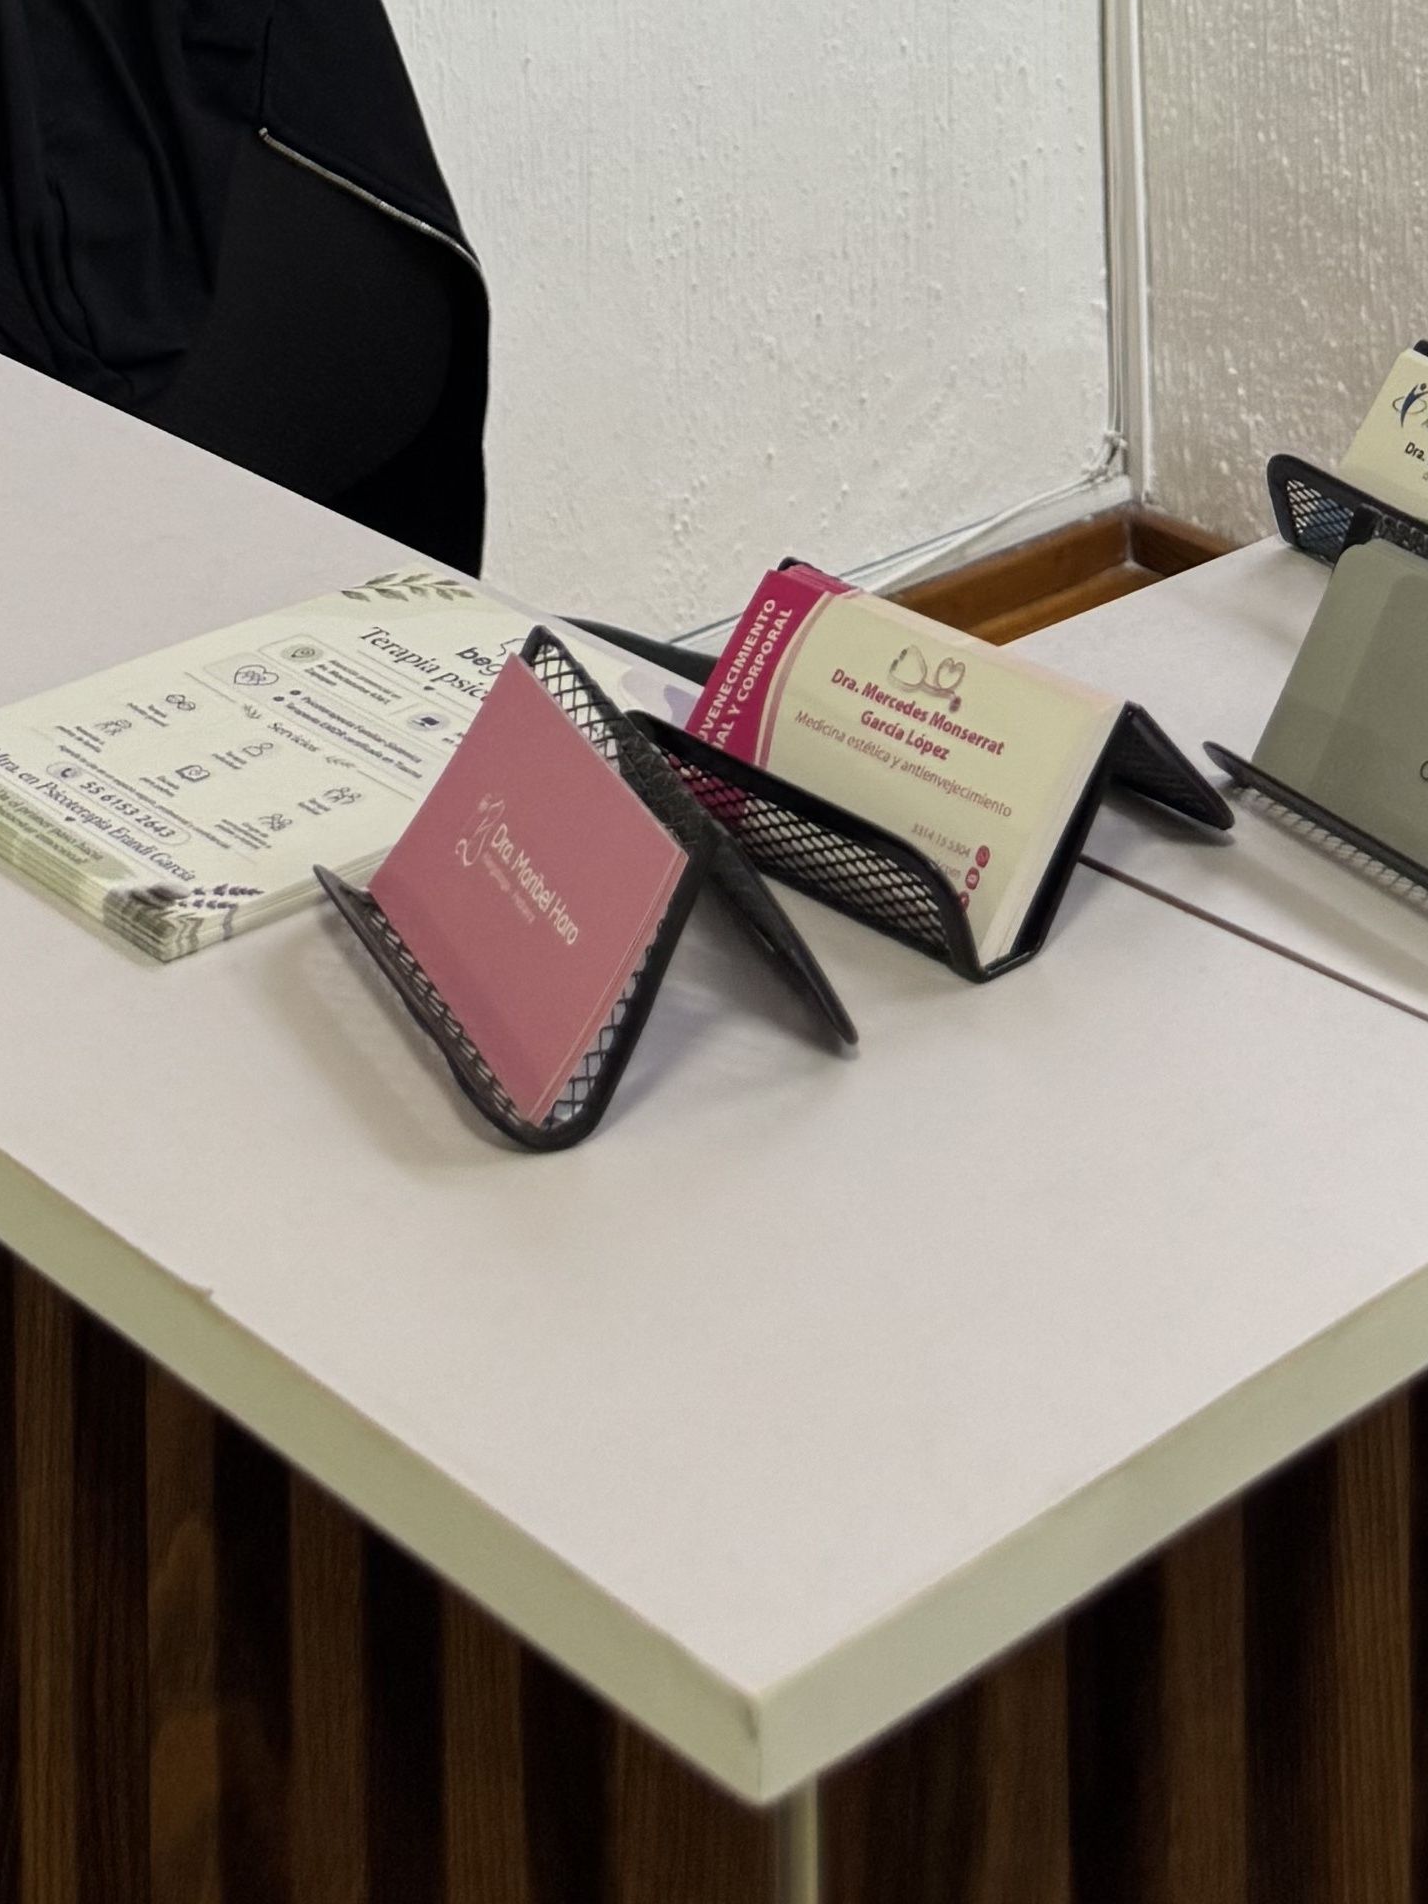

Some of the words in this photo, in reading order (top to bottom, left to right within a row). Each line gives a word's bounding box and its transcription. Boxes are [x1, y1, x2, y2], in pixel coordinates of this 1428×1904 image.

[1404, 442, 1425, 462] Dra.
[359, 626, 440, 673] Terapia
[429, 672, 489, 702] psic
[728, 703, 740, 715] Y
[737, 608, 793, 702] CORPORAL
[266, 721, 325, 752] Servicios
[831, 668, 859, 693] Dra.
[861, 682, 929, 722] Mercedes
[928, 711, 1005, 756] Monserrat
[860, 710, 905, 742] García
[905, 728, 950, 761] López
[794, 710, 846, 742] Medicina
[847, 734, 891, 763] estética
[891, 755, 902, 769] y
[900, 758, 1013, 818] antienvejecimiento
[16, 771, 42, 784] en
[31, 781, 119, 831] Psicoterapia
[107, 826, 158, 855] Erandi
[146, 851, 200, 881] García
[79, 780, 106, 794] 55
[98, 792, 140, 816] 6153
[135, 815, 176, 838] 2643
[511, 848, 557, 912] Maribel
[548, 897, 578, 945] Haro
